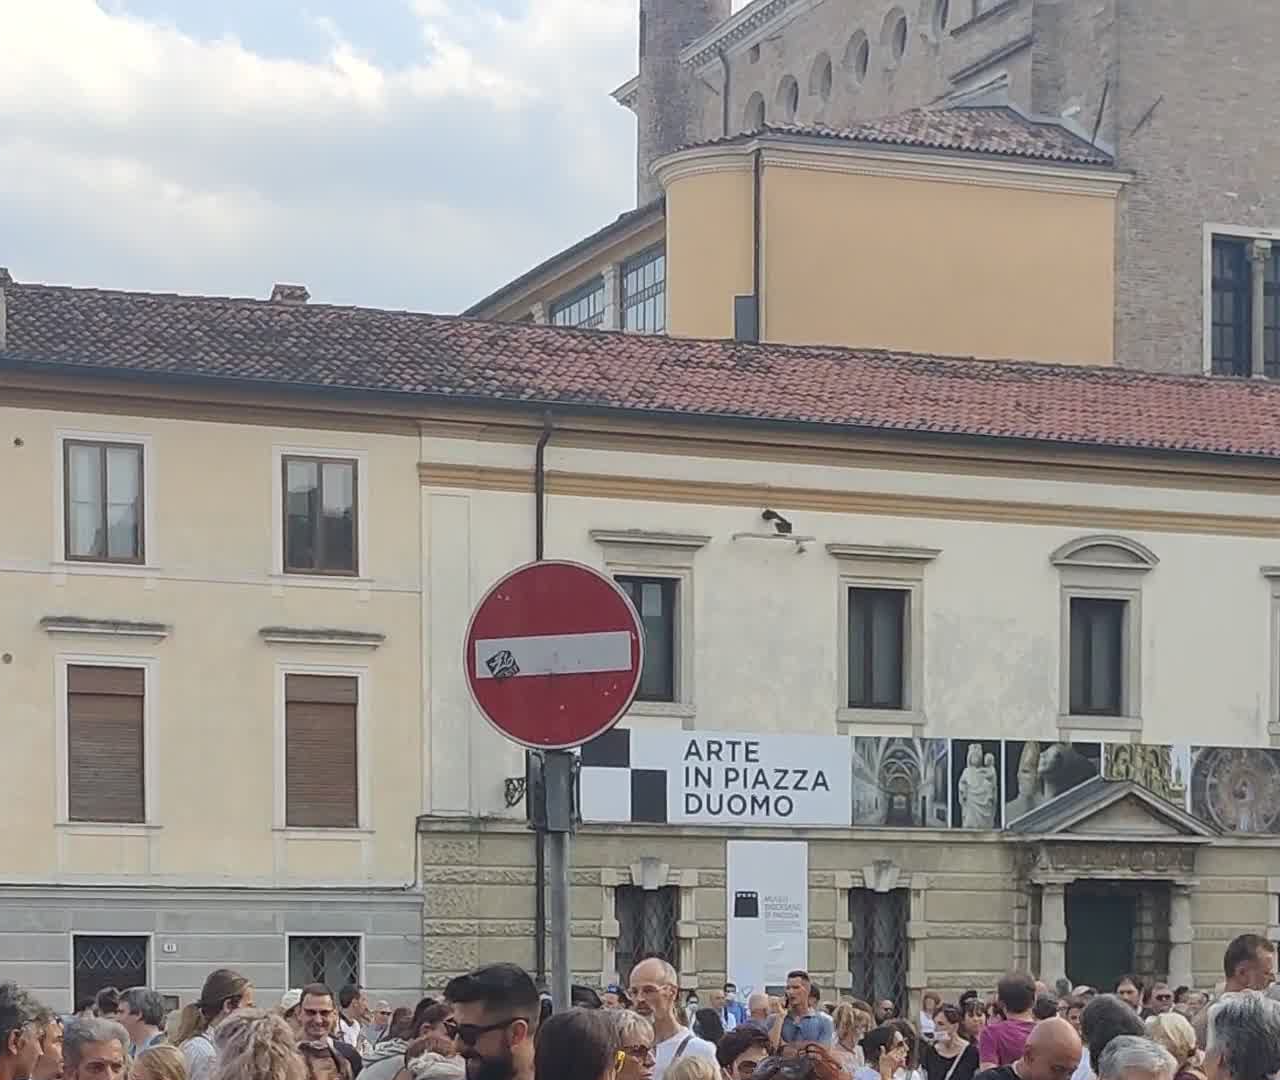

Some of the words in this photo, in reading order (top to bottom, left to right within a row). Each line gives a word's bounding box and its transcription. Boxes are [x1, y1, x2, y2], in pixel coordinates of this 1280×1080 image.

[683, 739, 760, 763] ARTE
[685, 766, 712, 789] IN
[724, 767, 830, 792] PIAZZA
[685, 793, 794, 817] DUOMO
